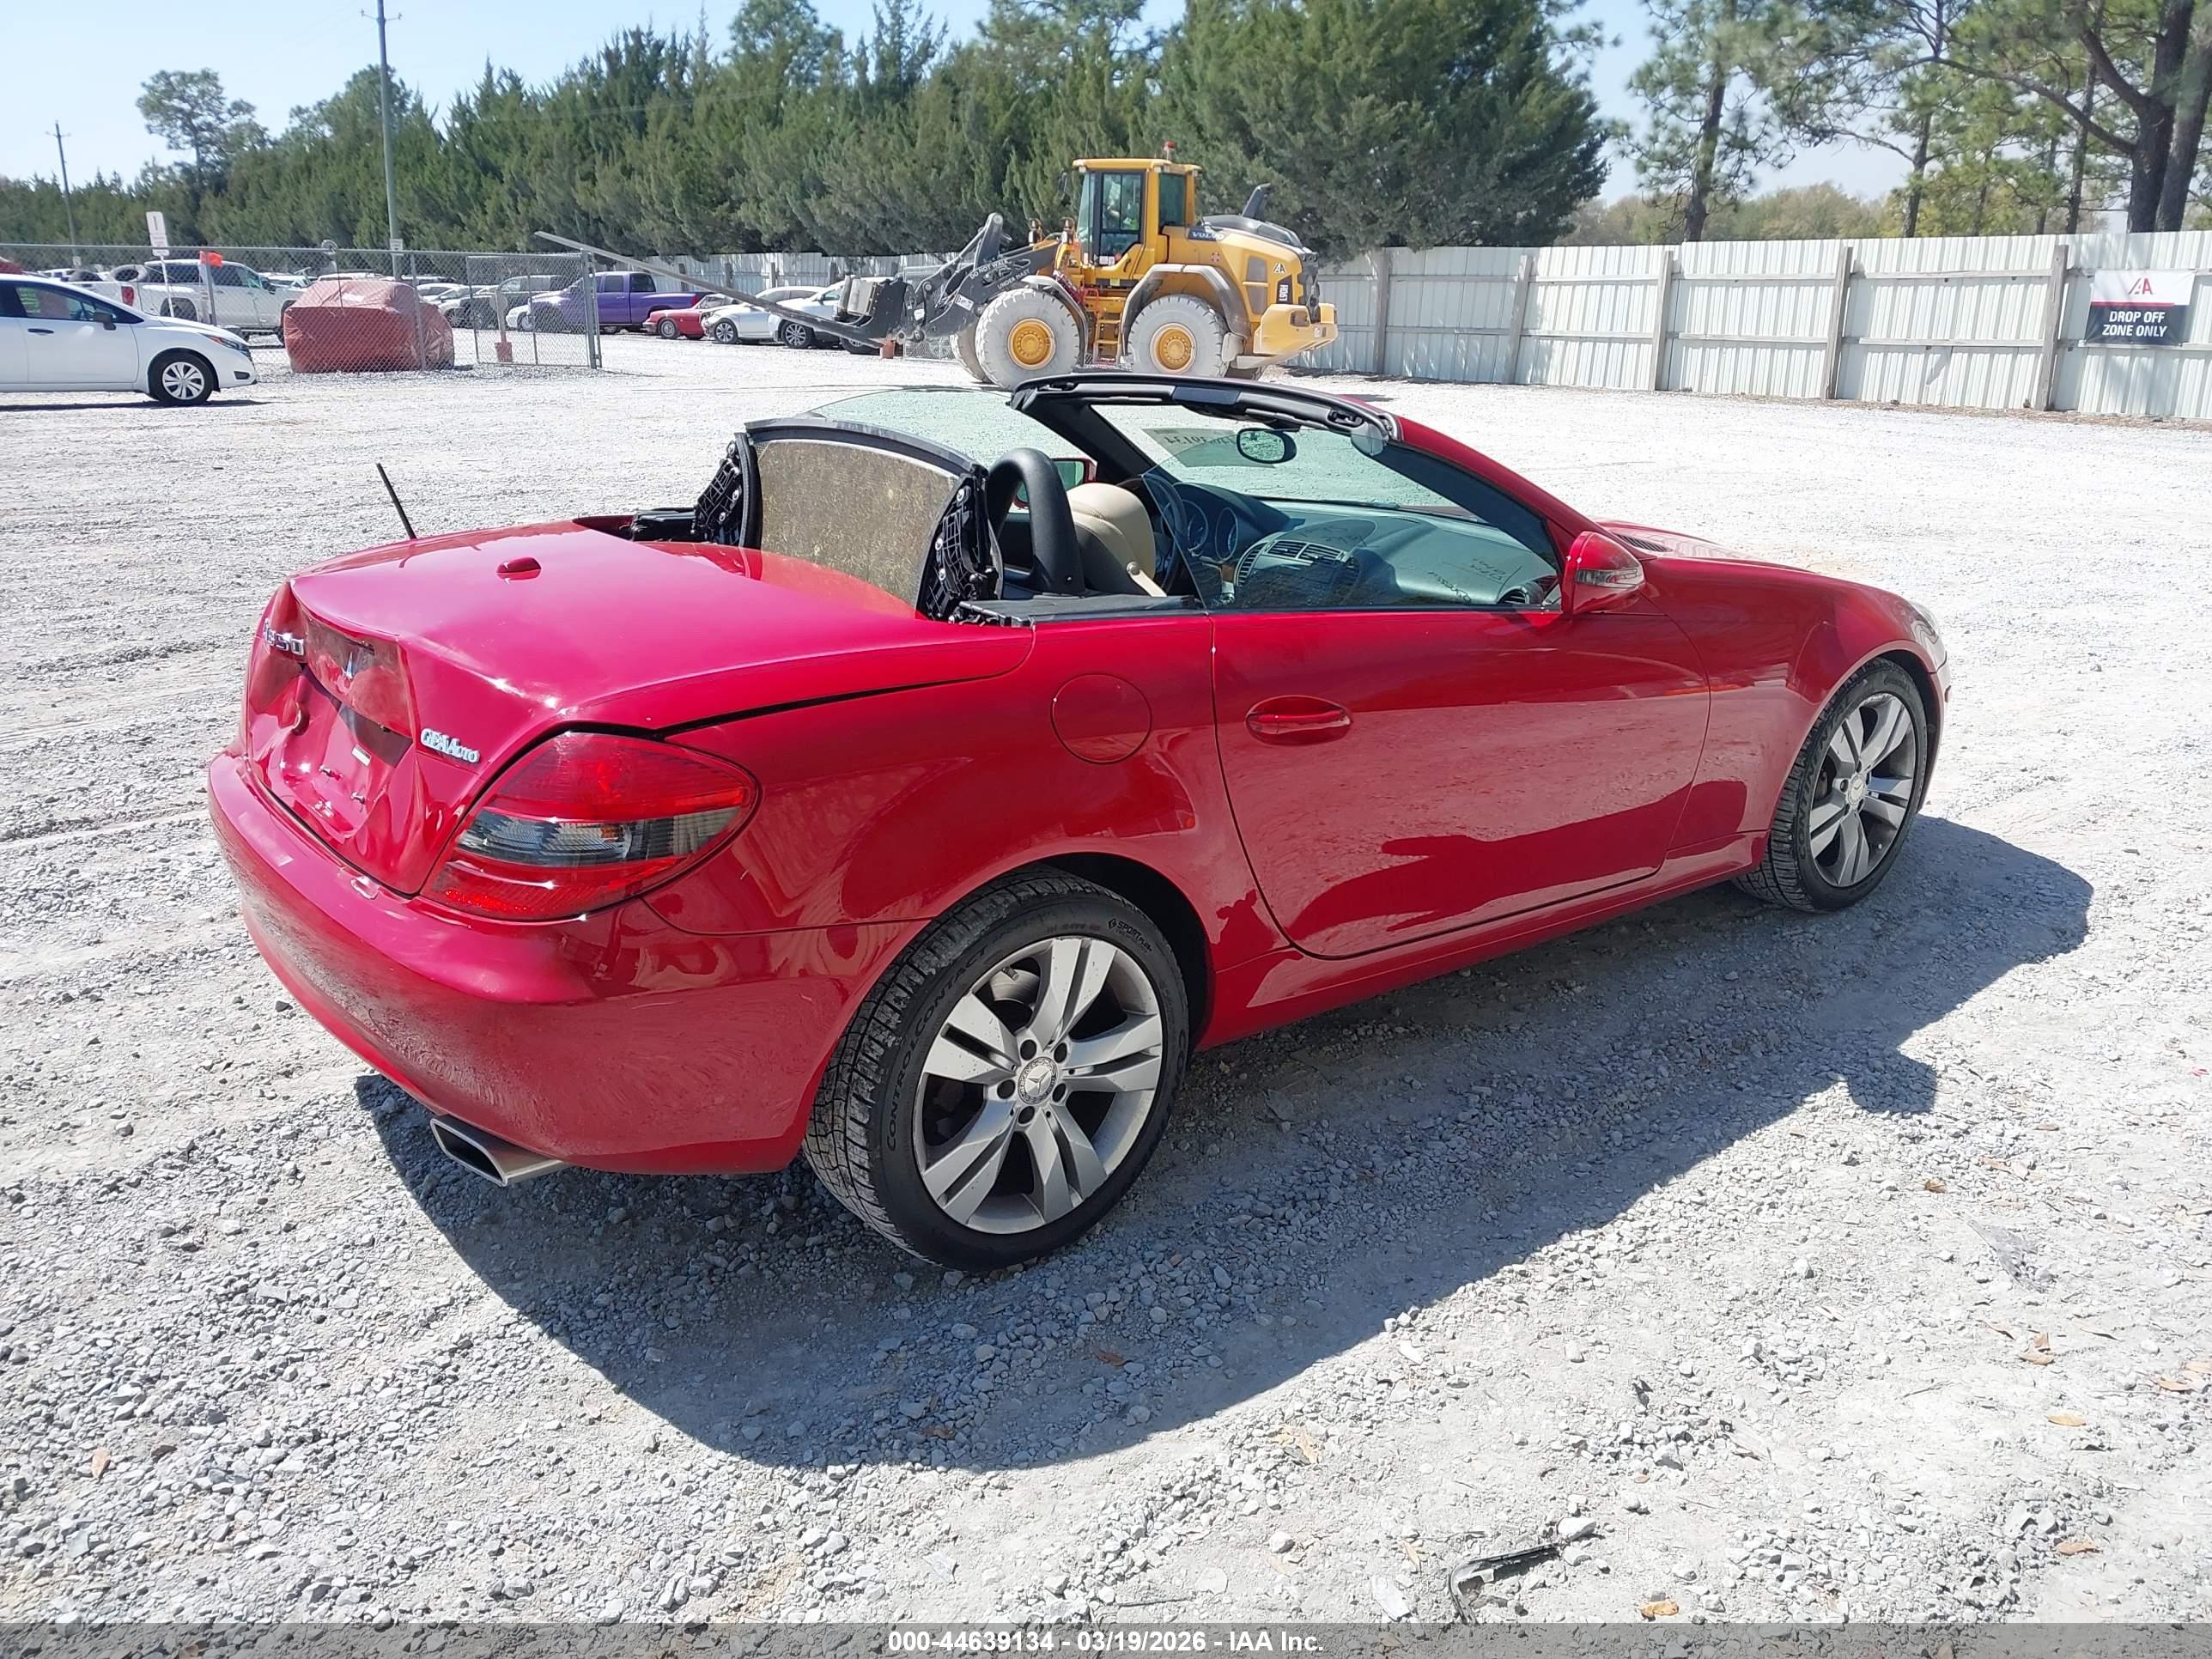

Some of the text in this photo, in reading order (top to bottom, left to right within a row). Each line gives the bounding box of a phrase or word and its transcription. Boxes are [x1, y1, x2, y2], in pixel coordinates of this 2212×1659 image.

[1192, 231, 1224, 240] VOLVO
[979, 264, 991, 273] NOT
[992, 259, 1010, 268] WALK
[997, 269, 1030, 289] UNDER MAST
[2109, 311, 2166, 324] DROP OFF
[2102, 324, 2168, 337] ZONE ONLY
